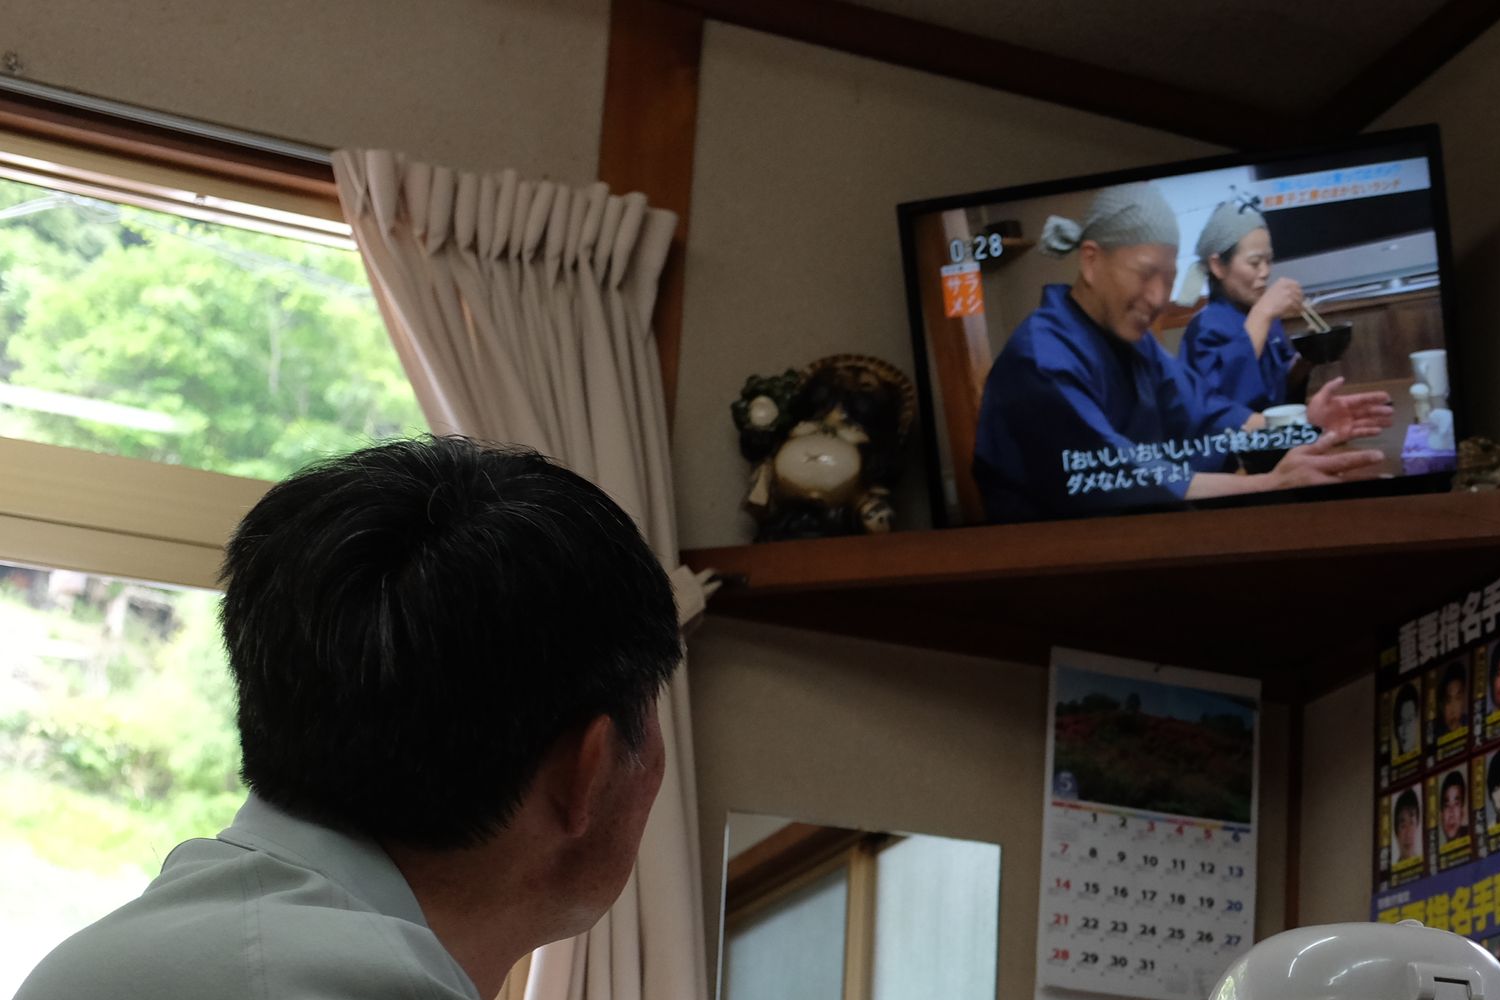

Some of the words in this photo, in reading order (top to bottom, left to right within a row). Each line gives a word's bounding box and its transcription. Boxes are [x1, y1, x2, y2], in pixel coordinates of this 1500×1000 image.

[1062, 424, 1319, 472] 「おいしいおいしい」で終わったら
[1060, 771, 1072, 791] 5
[1060, 842, 1070, 854] 7
[1088, 847, 1098, 858] 8
[1117, 851, 1127, 862] 9
[1142, 854, 1159, 867] 10
[1171, 858, 1186, 871] 11
[1200, 861, 1215, 874] 12
[1228, 865, 1244, 879] 13
[1055, 877, 1071, 891] 14
[1084, 881, 1100, 894] 15
[1113, 886, 1129, 898] 16
[1141, 889, 1158, 902] 17
[1169, 893, 1186, 905] 18
[1198, 897, 1215, 909] 19
[1226, 900, 1244, 912] 20
[1053, 913, 1069, 925] 21
[1081, 917, 1099, 930] 22
[1110, 921, 1128, 933] 23
[1139, 924, 1157, 937] 24
[1168, 927, 1186, 940] 25
[1197, 930, 1214, 943] 26
[1225, 934, 1242, 946] 27
[1052, 949, 1070, 960] 28
[1081, 952, 1099, 964] 29
[1110, 955, 1128, 967] 30
[1139, 959, 1156, 971] 31
